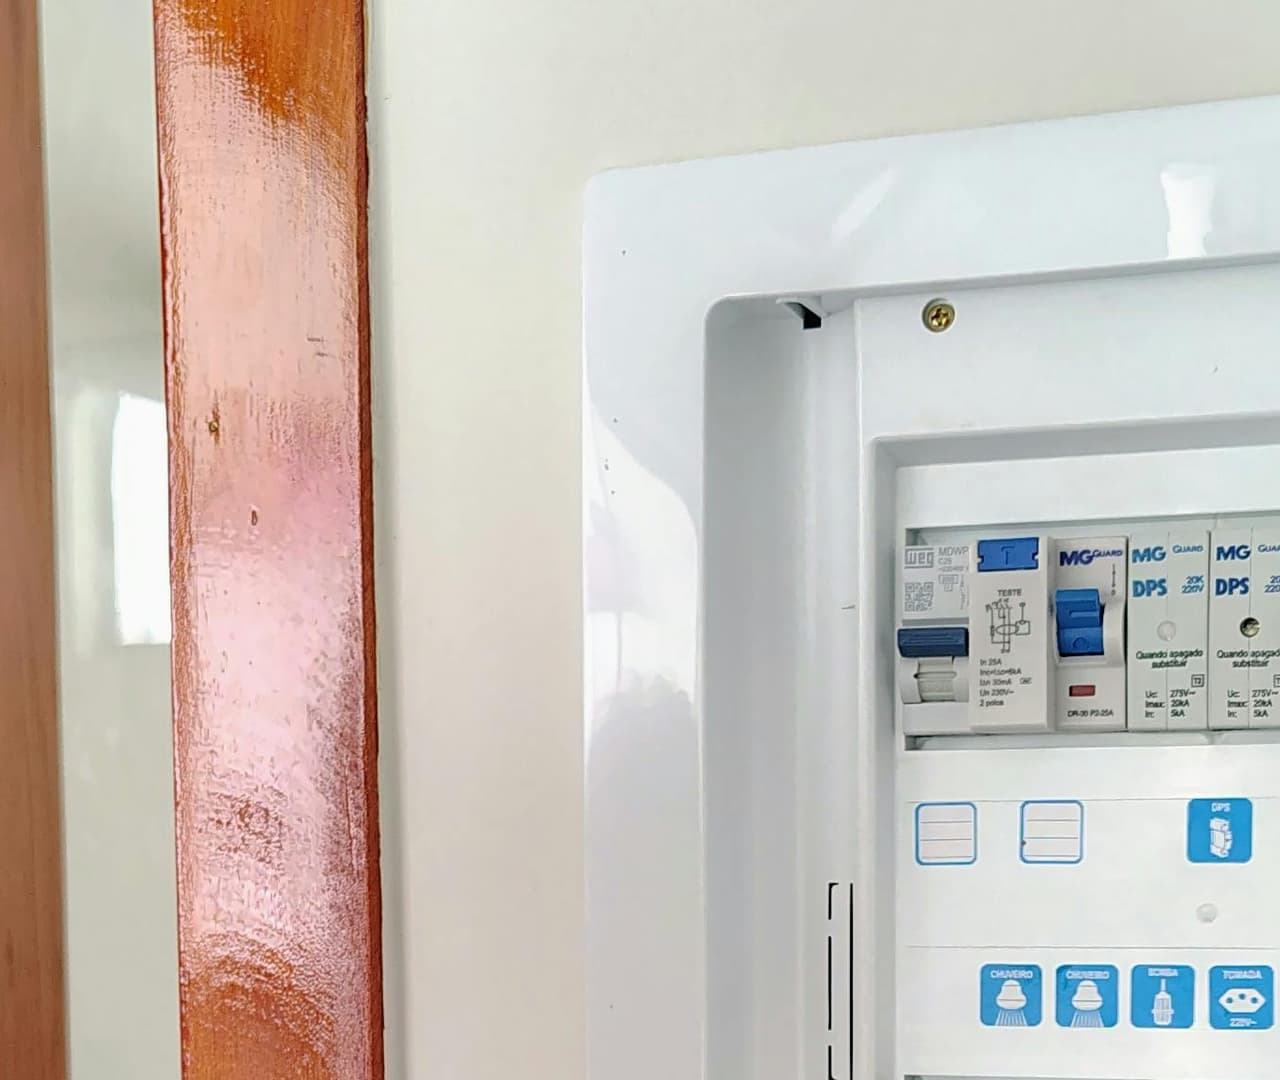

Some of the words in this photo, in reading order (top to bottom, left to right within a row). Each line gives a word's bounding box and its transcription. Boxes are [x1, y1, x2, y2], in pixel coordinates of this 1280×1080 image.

[1060, 550, 1094, 566] MG
[1132, 546, 1166, 563] MG
[1216, 545, 1251, 560] MG
[1132, 578, 1167, 597] DPS
[1181, 584, 1205, 594] 220V
[1215, 577, 1250, 596] DPS
[1136, 650, 1167, 660] Quando
[1169, 648, 1204, 660] apagado
[1217, 649, 1248, 659] Quando
[990, 969, 1033, 979] CHUVEIRO
